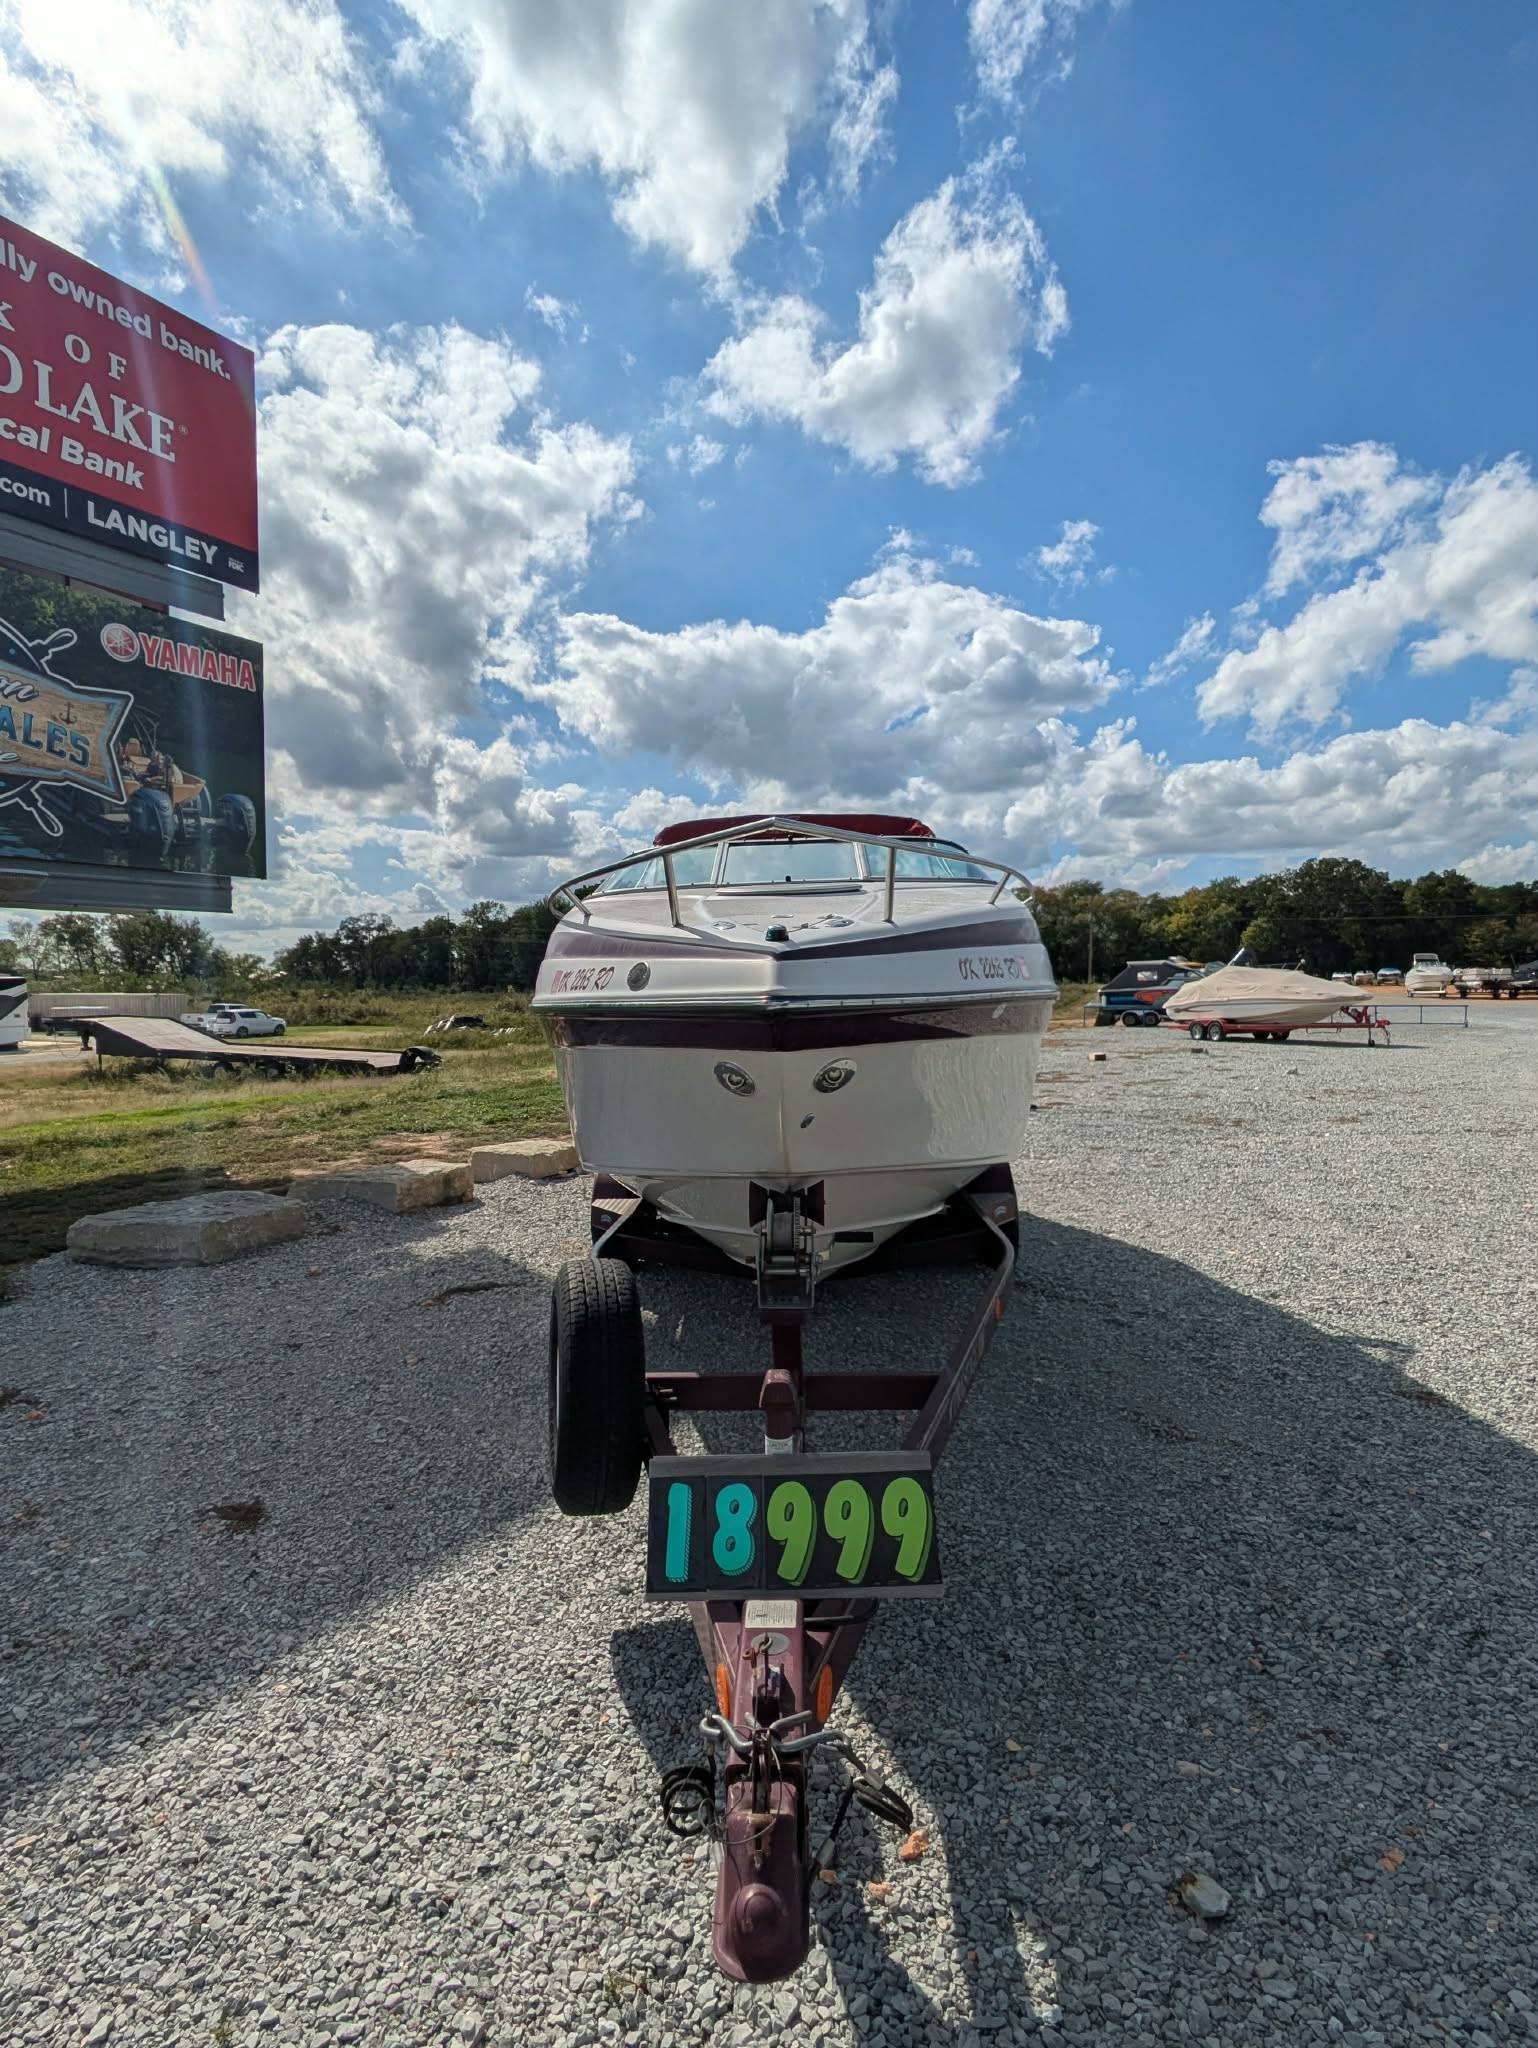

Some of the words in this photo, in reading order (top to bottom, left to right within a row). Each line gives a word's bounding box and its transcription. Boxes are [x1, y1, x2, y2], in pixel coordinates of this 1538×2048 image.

[48, 271, 152, 340] owned
[159, 322, 231, 381] bank.
[33, 359, 175, 462] LAKE
[60, 435, 144, 490] Bank
[87, 500, 218, 565] LANGLEY
[139, 632, 257, 692] YAMAHA
[665, 1477, 936, 1586] 18999
